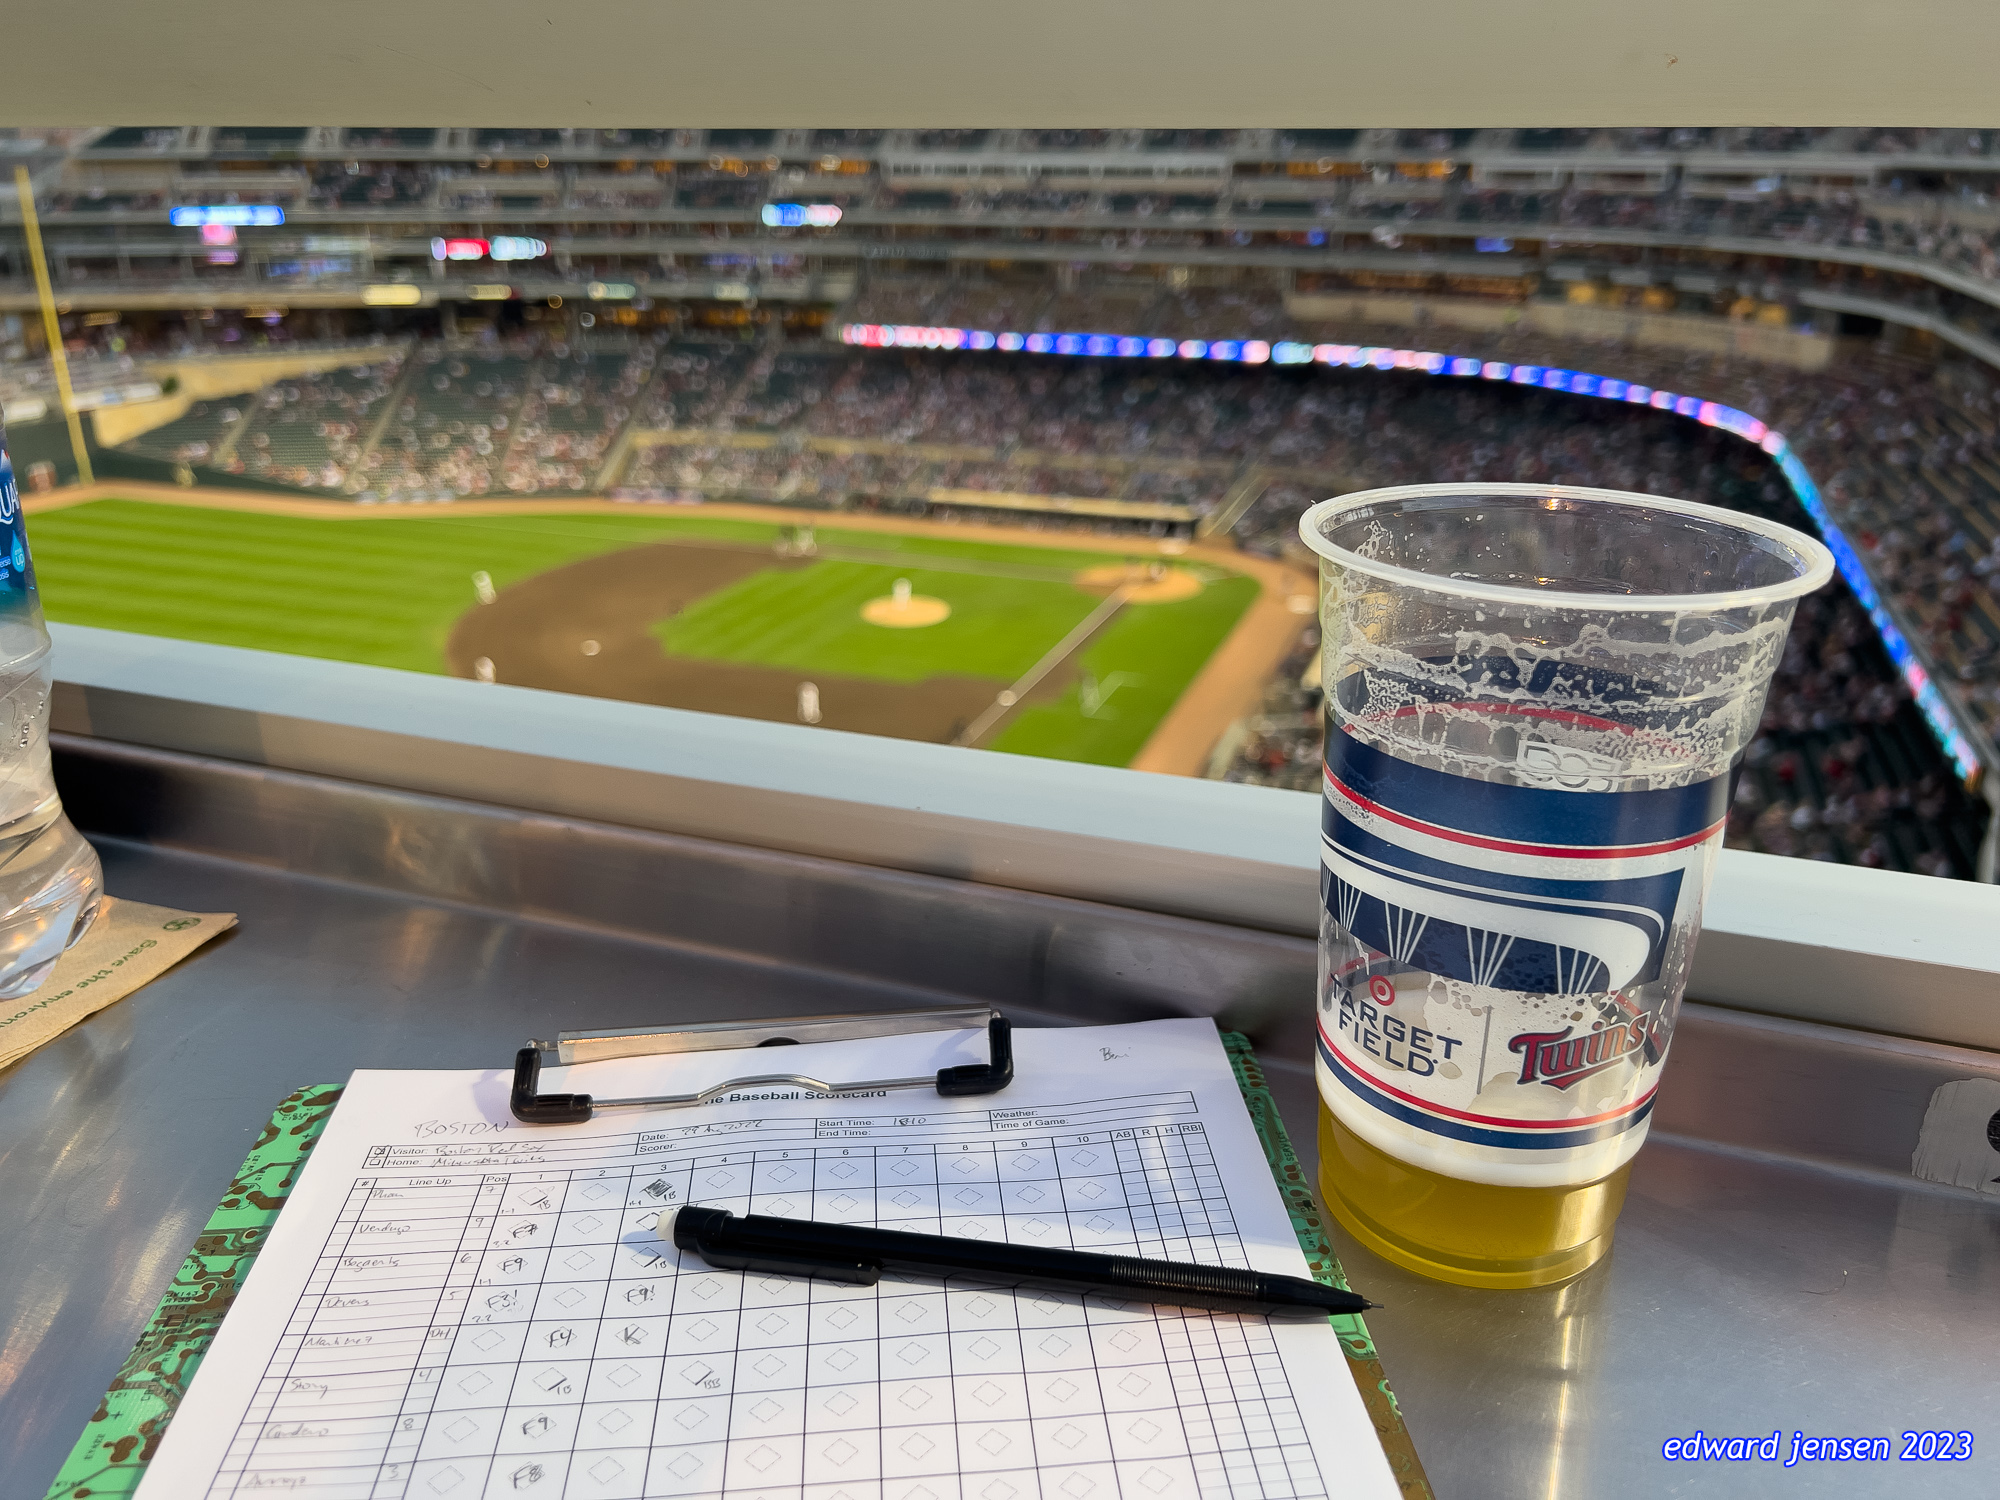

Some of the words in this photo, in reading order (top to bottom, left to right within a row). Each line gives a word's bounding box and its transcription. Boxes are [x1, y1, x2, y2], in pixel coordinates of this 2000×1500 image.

[76, 969, 113, 990] the
[1330, 973, 1463, 1060] TARGET
[1339, 1008, 1438, 1077] FIELD
[1508, 1010, 1652, 1093] Twins
[730, 1091, 799, 1102] Baseball
[992, 1109, 1038, 1119] Weather:
[414, 1120, 509, 1138] BOSTON
[819, 1119, 844, 1127] Start
[848, 1118, 875, 1126] Time:
[993, 1120, 1019, 1130] Time
[1021, 1120, 1032, 1128] of
[1035, 1117, 1069, 1127] Game:
[641, 1132, 669, 1142] Date:
[842, 1128, 871, 1136] Time:
[391, 1146, 428, 1155] Visitor:
[640, 1142, 677, 1153] Scorer:
[386, 1157, 422, 1166] Home:
[409, 1178, 432, 1186] Line
[436, 1177, 452, 1188] Up
[902, 1146, 909, 1154] 7
[1077, 1135, 1090, 1143] 10
[1115, 1130, 1132, 1139] AB
[1142, 1128, 1151, 1137] R
[1165, 1126, 1174, 1134] H
[1182, 1123, 1202, 1133] RBI
[475, 1217, 484, 1228] 9
[461, 1252, 472, 1263] 6
[503, 1257, 523, 1272] F9
[623, 1326, 641, 1345] K
[419, 1369, 432, 1382] 4
[403, 1417, 414, 1431] 8
[522, 1416, 548, 1435] F9
[387, 1464, 399, 1480] 3
